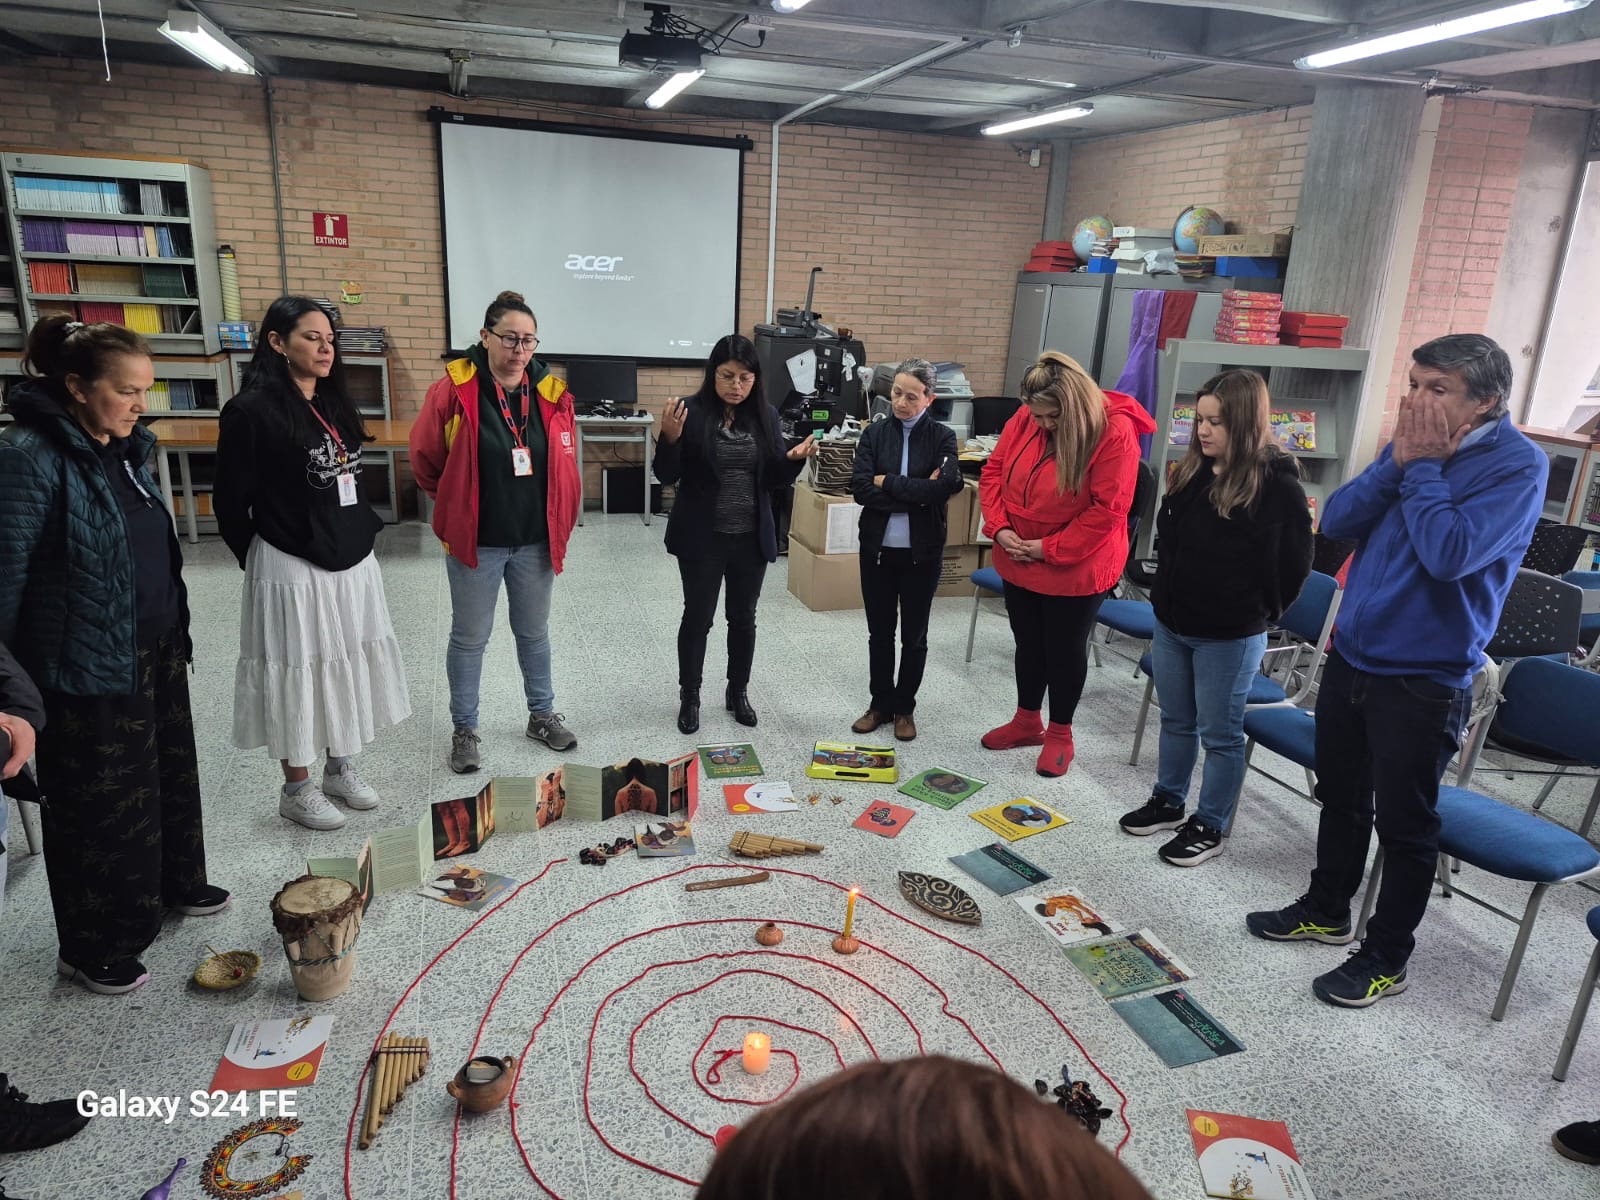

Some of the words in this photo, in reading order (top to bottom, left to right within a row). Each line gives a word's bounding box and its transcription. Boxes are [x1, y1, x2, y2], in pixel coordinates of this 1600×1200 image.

[315, 236, 347, 246] EXTINTOR
[564, 254, 624, 272] acer
[1270, 412, 1290, 423] RIA
[1108, 956, 1143, 985] ESCUELA
